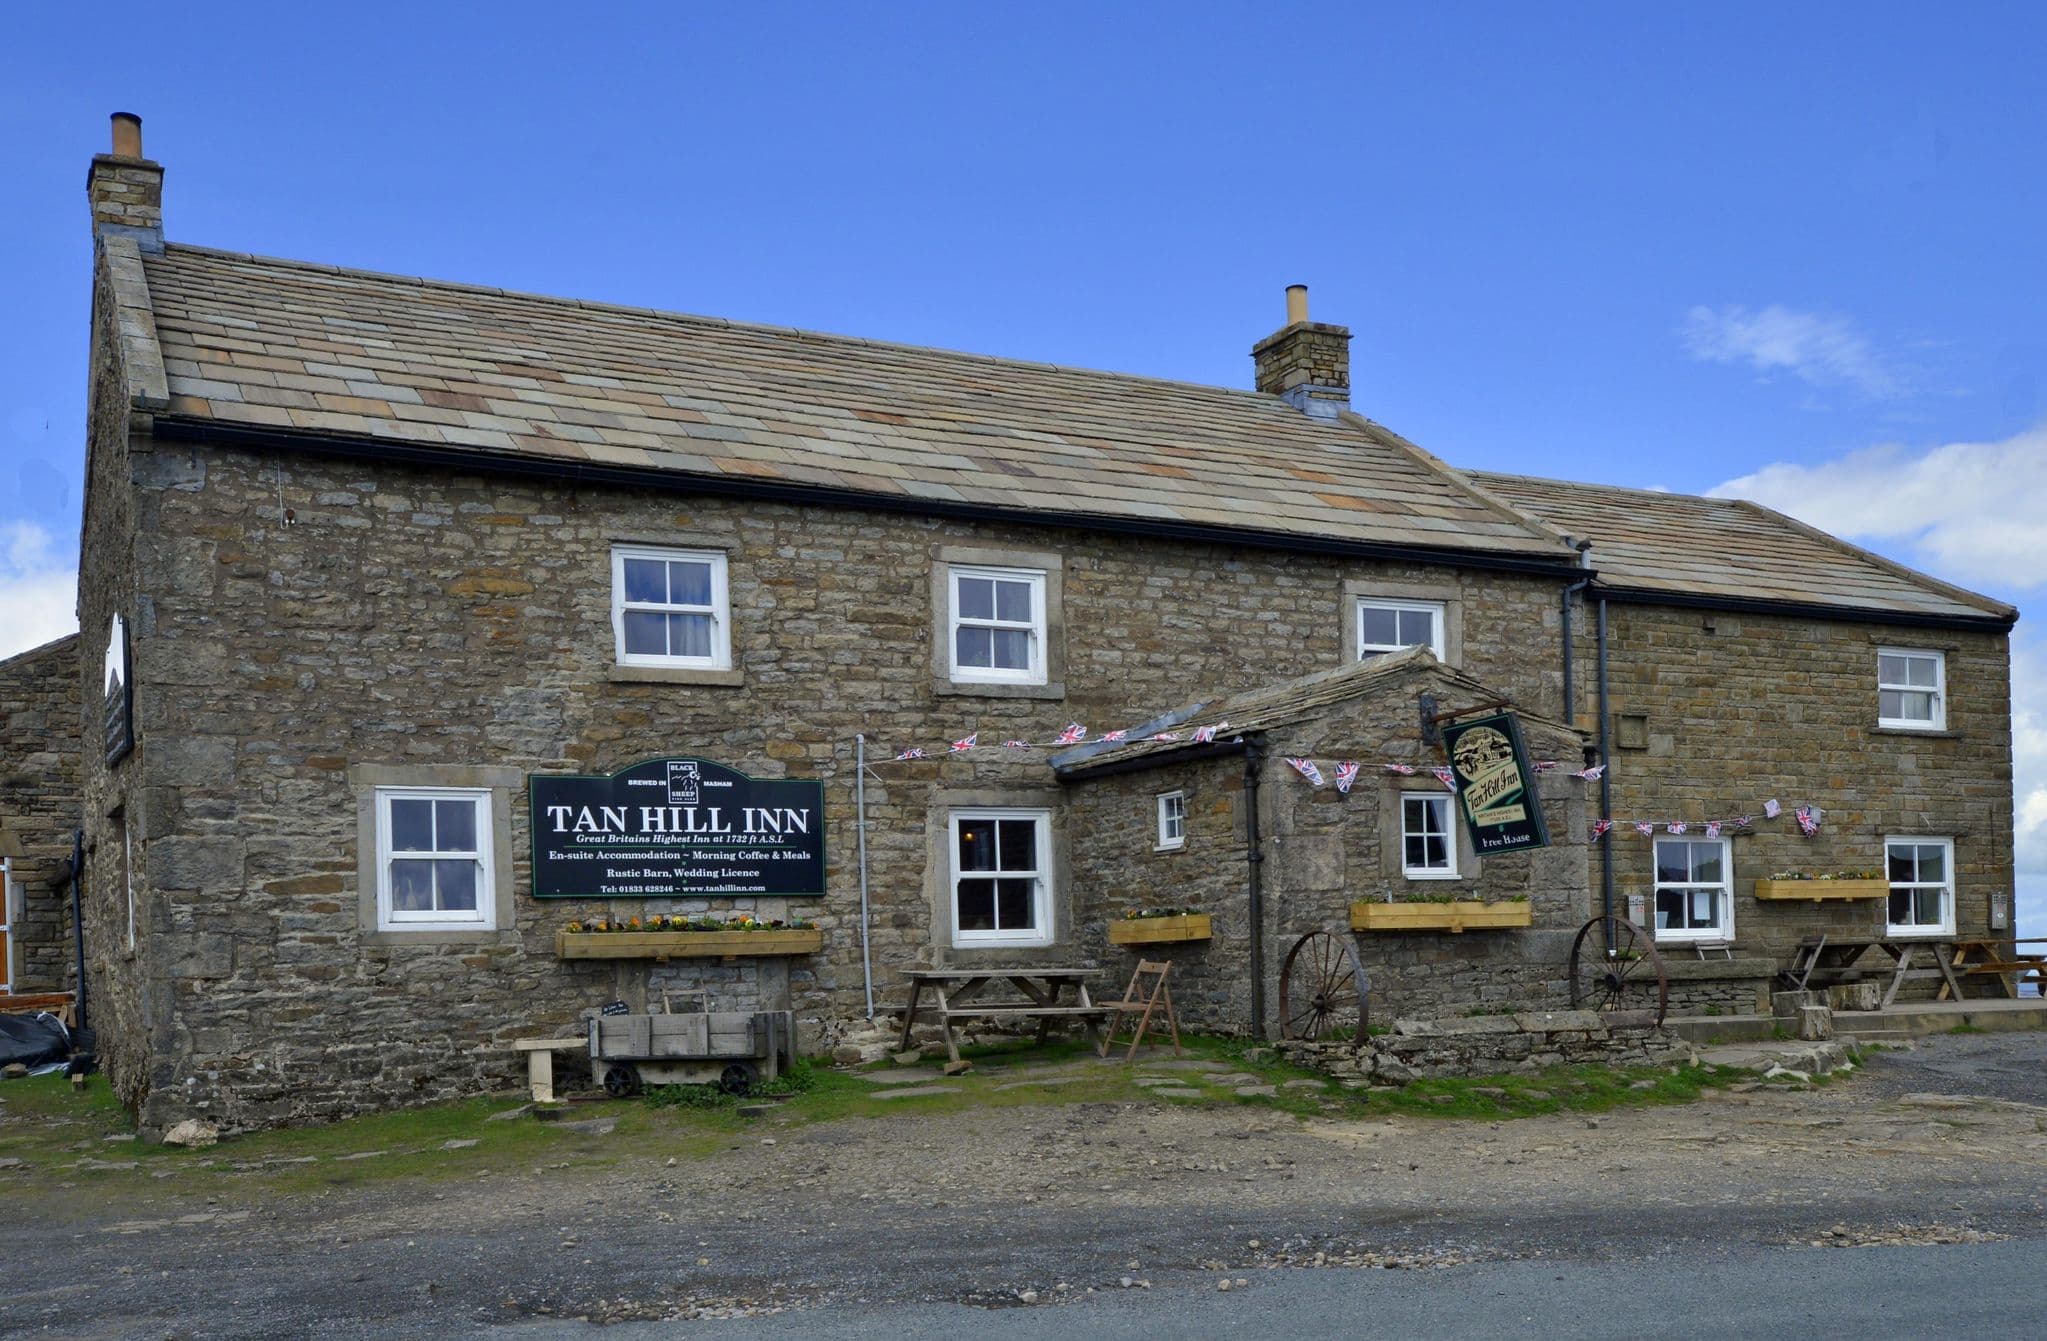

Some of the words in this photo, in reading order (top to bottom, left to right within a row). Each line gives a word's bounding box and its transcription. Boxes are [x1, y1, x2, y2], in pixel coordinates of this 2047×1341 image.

[1467, 789, 1484, 811] Tan
[1480, 778, 1500, 802] Hill
[1500, 770, 1518, 791] Inn
[547, 805, 628, 833] TAN
[639, 806, 731, 833] HILL
[743, 807, 809, 834] INN
[576, 834, 605, 843] Great
[607, 834, 650, 843] Britains
[652, 834, 690, 845] Highest
[693, 835, 711, 843] Inn
[726, 835, 747, 844] 1732
[749, 835, 757, 844] ft
[1482, 838, 1502, 847] Free
[1503, 834, 1530, 845] House
[549, 850, 594, 860] En-suite
[596, 850, 681, 860] Accommodation
[692, 851, 736, 861] Morning
[738, 851, 769, 860] Coffee
[772, 851, 780, 860] &
[782, 851, 811, 860] Meals
[606, 868, 641, 878] Rustic
[643, 869, 672, 879] Barn,
[674, 868, 719, 879] Wedding
[721, 868, 760, 878] Licence
[600, 885, 617, 893] Tel:
[619, 885, 643, 893] 01833
[645, 885, 674, 893] 628246
[682, 884, 766, 893] www.tanhillinn.com
